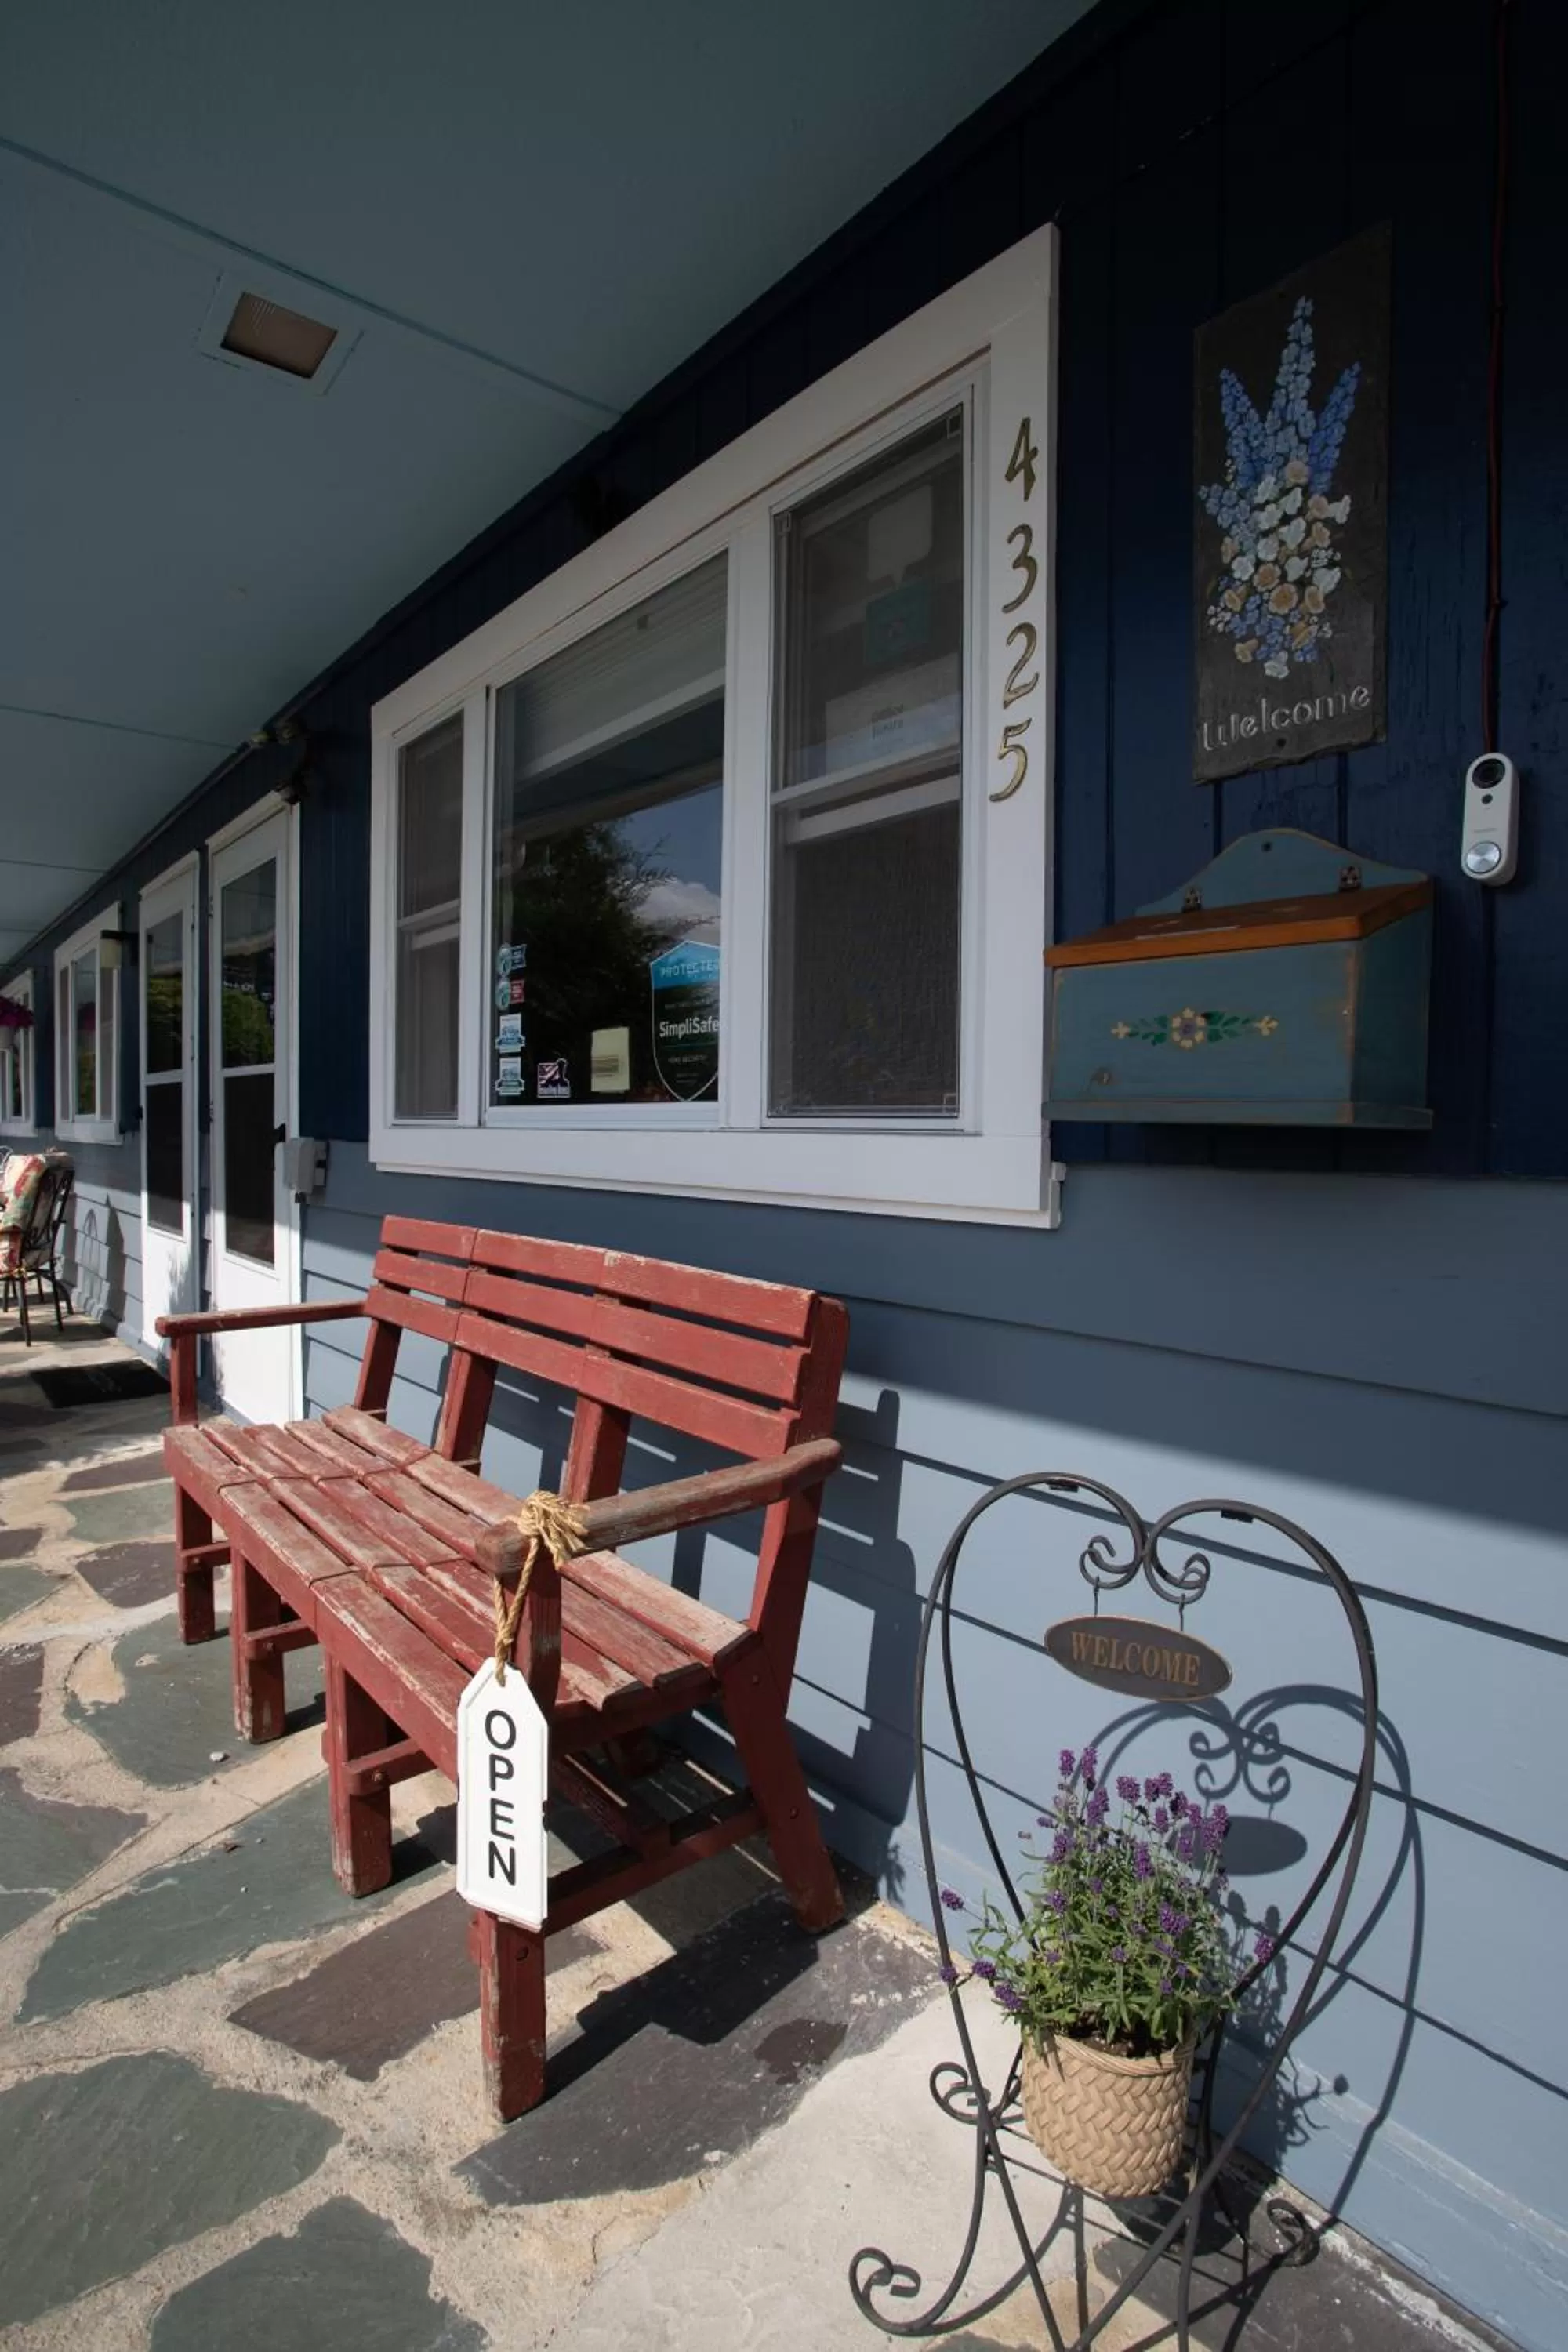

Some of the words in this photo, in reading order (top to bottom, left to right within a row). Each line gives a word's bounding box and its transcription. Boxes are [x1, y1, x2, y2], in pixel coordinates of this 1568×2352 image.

[989, 416, 1039, 802] 4325
[1203, 685, 1370, 751] Welcome
[659, 1016, 719, 1040] SimpliSafe
[1071, 1631, 1201, 1686] WELCOME
[485, 1709, 517, 1886] OPEN
